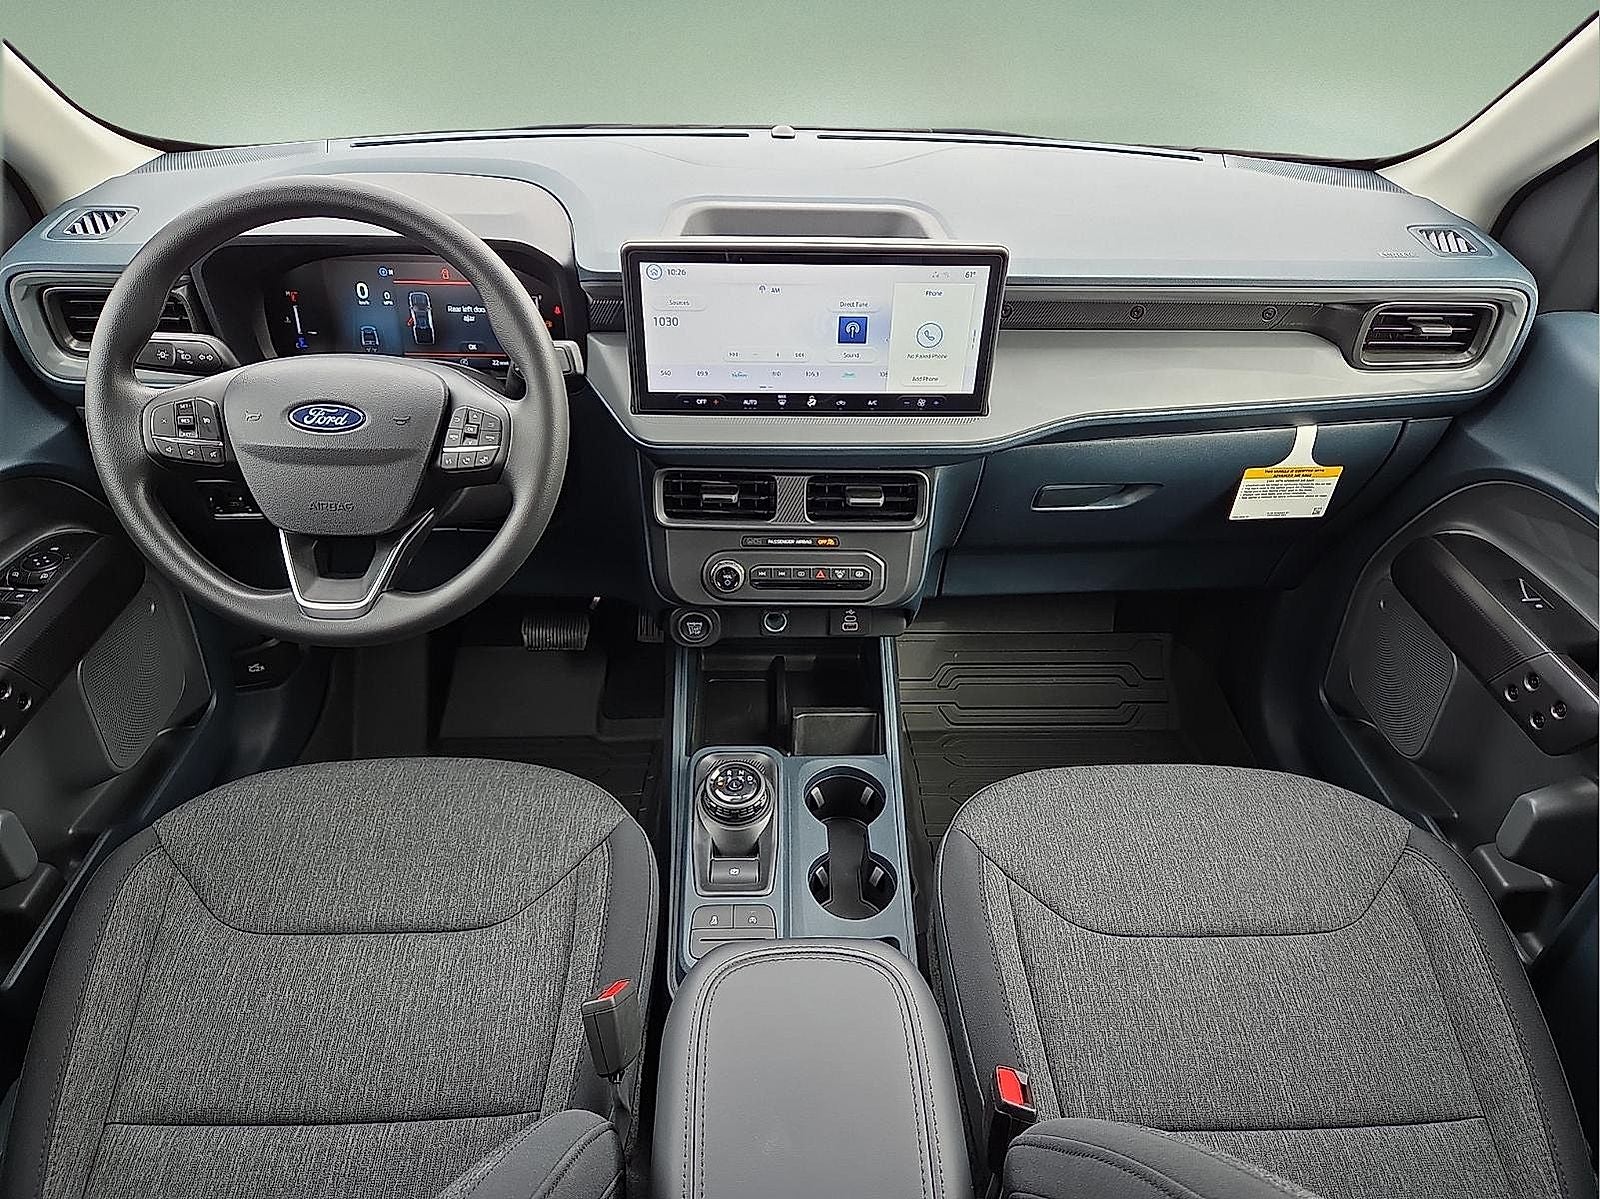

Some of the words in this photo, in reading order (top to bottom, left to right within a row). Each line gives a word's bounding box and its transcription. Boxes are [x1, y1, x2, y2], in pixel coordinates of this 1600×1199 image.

[356, 282, 369, 299] 0
[383, 291, 391, 300] 0
[447, 305, 461, 313] Rear
[462, 305, 473, 313] left
[653, 316, 679, 327] 1030
[303, 407, 348, 426] Ford
[309, 501, 354, 513] AIRBAG
